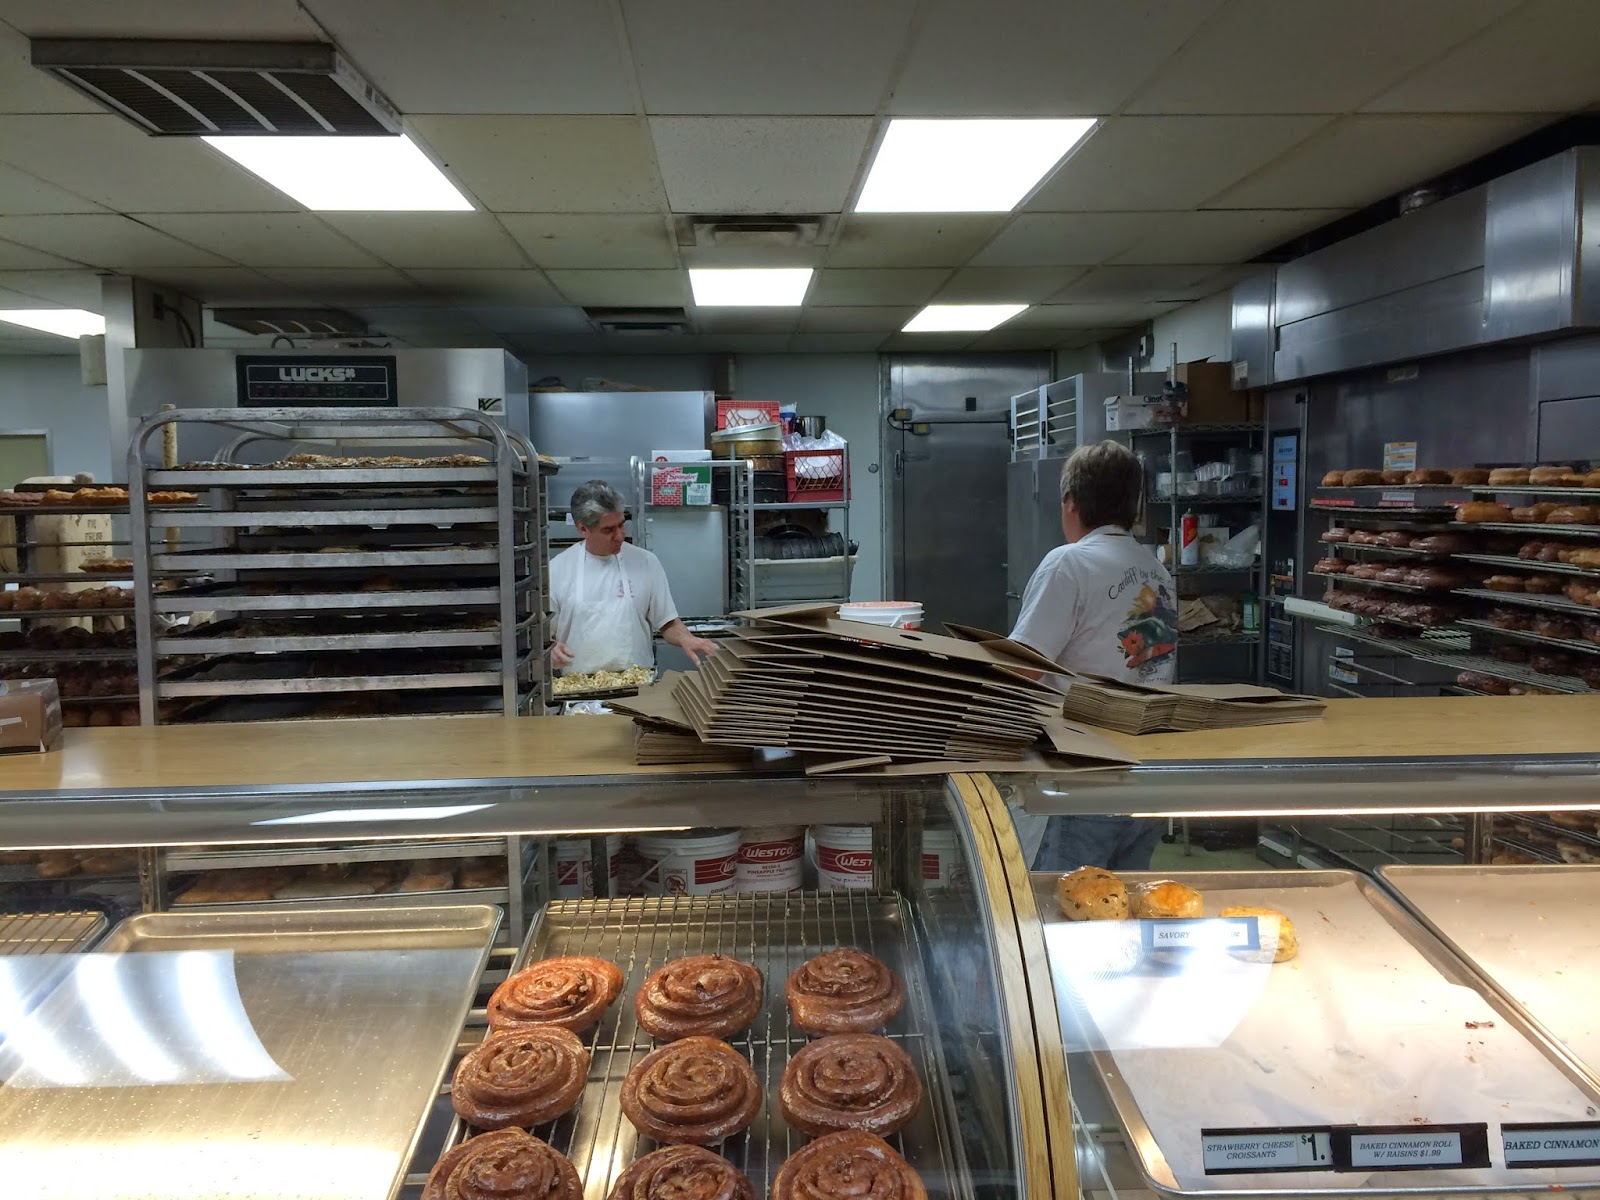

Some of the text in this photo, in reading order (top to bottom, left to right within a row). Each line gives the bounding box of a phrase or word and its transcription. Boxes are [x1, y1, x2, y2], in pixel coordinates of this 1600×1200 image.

[279, 368, 346, 381] LUCKS
[1108, 566, 1139, 600] Cardiff
[746, 846, 793, 858] WESTCO
[840, 856, 872, 866] WEST
[1158, 931, 1190, 939] SAVORY
[1206, 1141, 1295, 1151] STRAWBERRY CHEESE
[1359, 1140, 1453, 1150] BAKED CINNAMON ROLL
[1504, 1139, 1600, 1150] BAKED CINNAMON
[1226, 1150, 1277, 1160] CROISSANTS
[1373, 1149, 1441, 1158] W/ RAISINS $1.99
